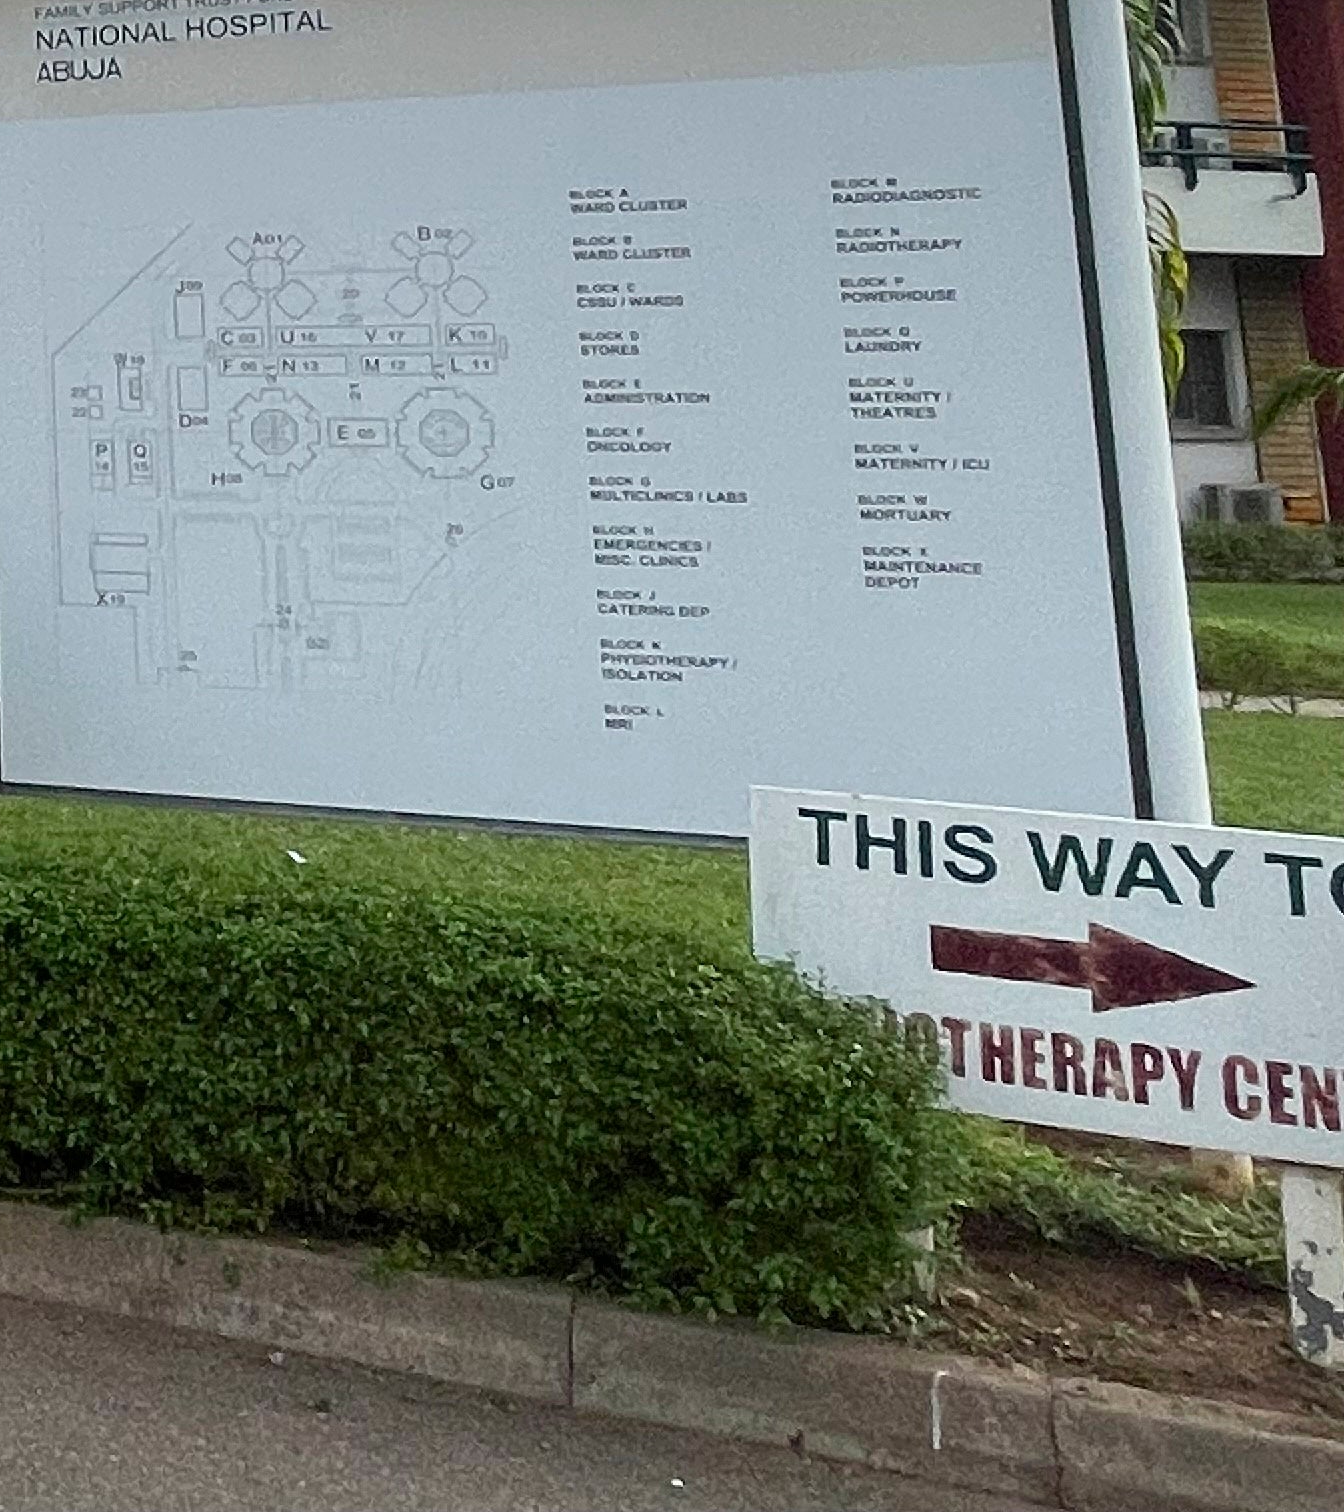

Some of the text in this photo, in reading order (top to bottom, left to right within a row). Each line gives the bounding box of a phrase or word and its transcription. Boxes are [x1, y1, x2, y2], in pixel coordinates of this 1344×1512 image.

[34, 2, 93, 19] FAMILY
[35, 8, 333, 50] NATIONAL HOSPITAL
[36, 56, 123, 83] ABUJA
[833, 188, 981, 203] RADIODIAGNOSTIC
[570, 199, 688, 213] WARD CLUSTER
[837, 239, 962, 253] RADIOTHERAPY
[573, 247, 691, 260] WARD CLUSTER
[841, 289, 957, 303] POWERHOUSE
[580, 344, 639, 356] STORES
[845, 341, 921, 353] LAUNDRY
[365, 359, 379, 372] M
[585, 392, 710, 404] ADMINISTRATION
[849, 391, 941, 403] MATERNITY
[851, 407, 936, 419] THEATRES
[337, 425, 349, 439] E
[587, 441, 671, 453] ONCOLOGY
[855, 459, 990, 470] MATERNITY ICU
[591, 490, 748, 503] MULTICLINICS LABS
[860, 509, 951, 521] MORTUARY
[595, 539, 702, 551] EMERGENCIES
[865, 561, 982, 575] MAINTENANCE
[865, 577, 919, 589] DEPOT
[598, 604, 710, 617] CATERING DEP
[601, 653, 728, 668] PHYSIOTHERAPY
[603, 669, 683, 681] ISOLATION
[799, 807, 1344, 917] THIS WAY T
[1222, 1054, 1344, 1133] CEN
